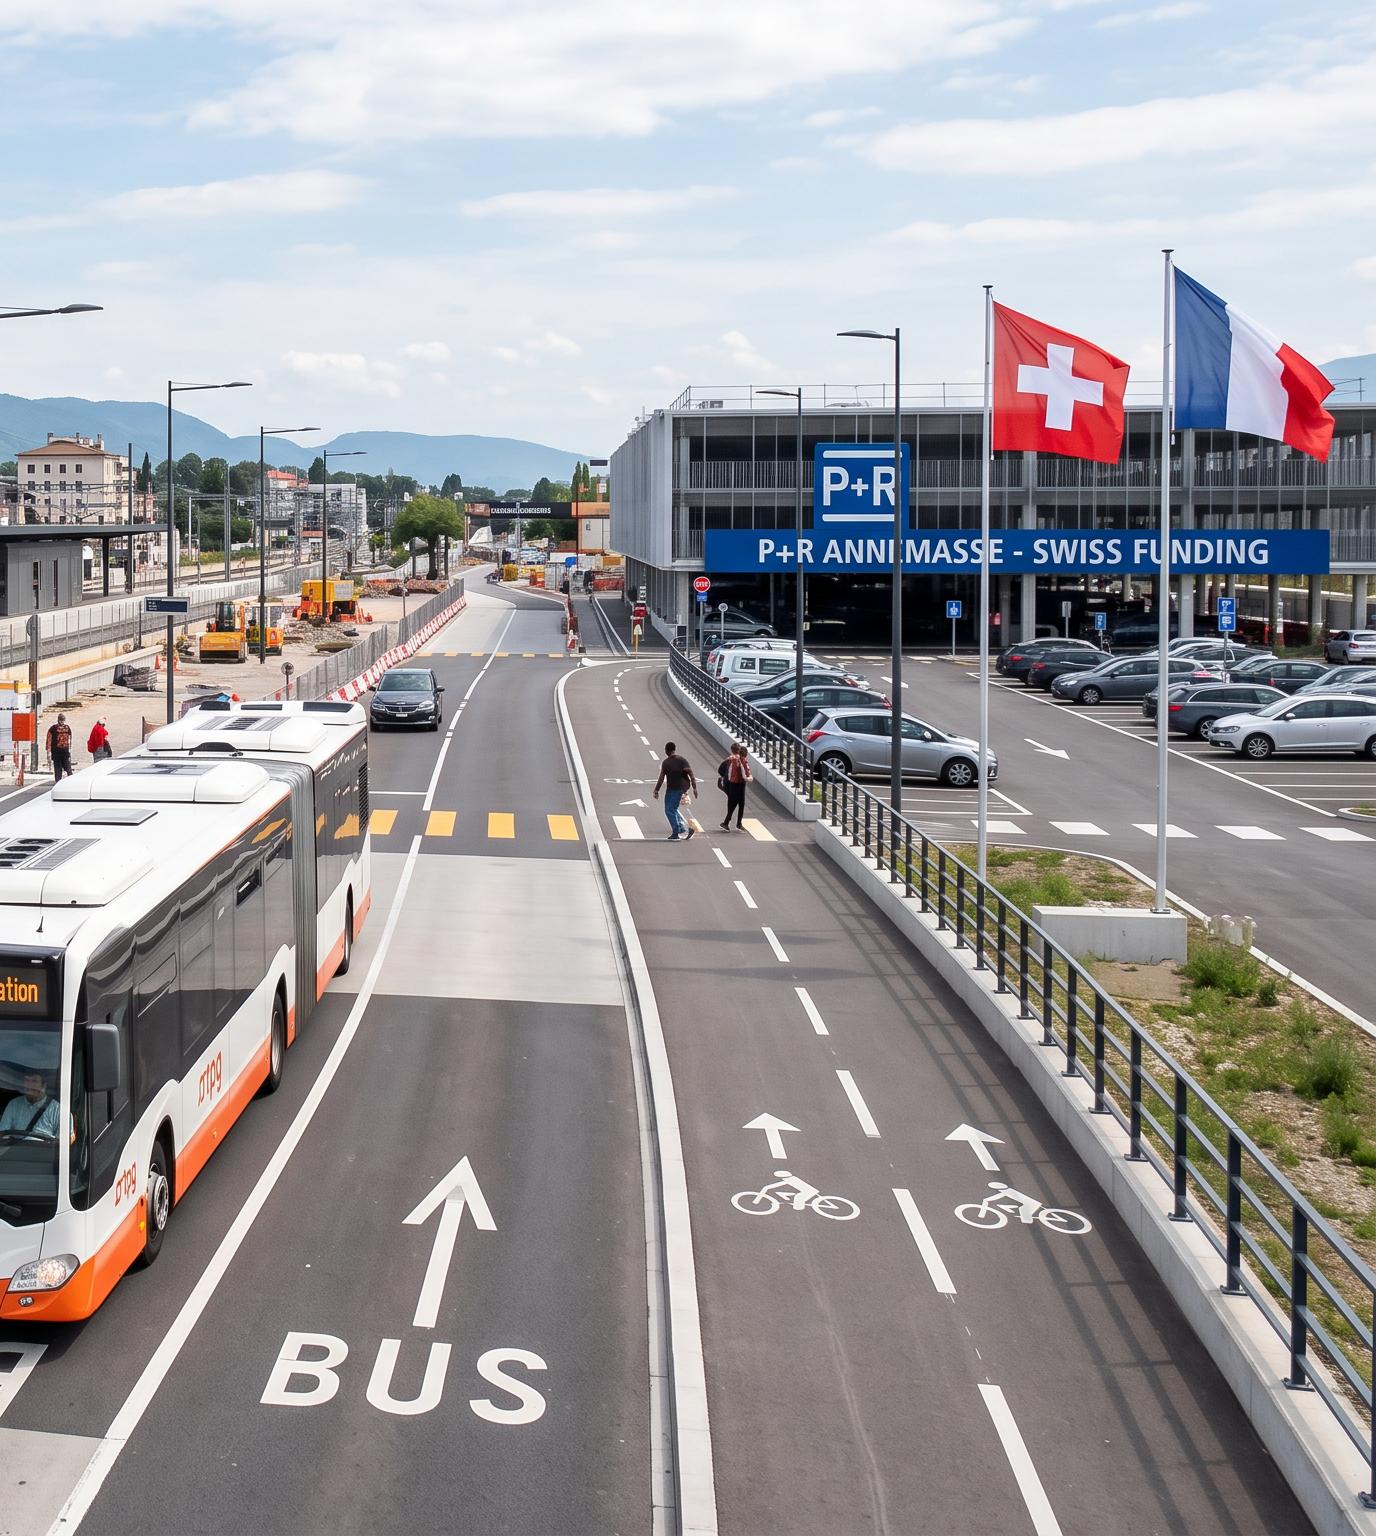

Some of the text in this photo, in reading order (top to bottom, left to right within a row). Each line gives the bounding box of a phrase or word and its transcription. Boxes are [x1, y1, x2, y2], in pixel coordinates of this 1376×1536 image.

[822, 466, 896, 506] P+R
[758, 538, 815, 564] P+R
[1033, 538, 1123, 565] SWISS
[259, 1331, 548, 1425] BUS
